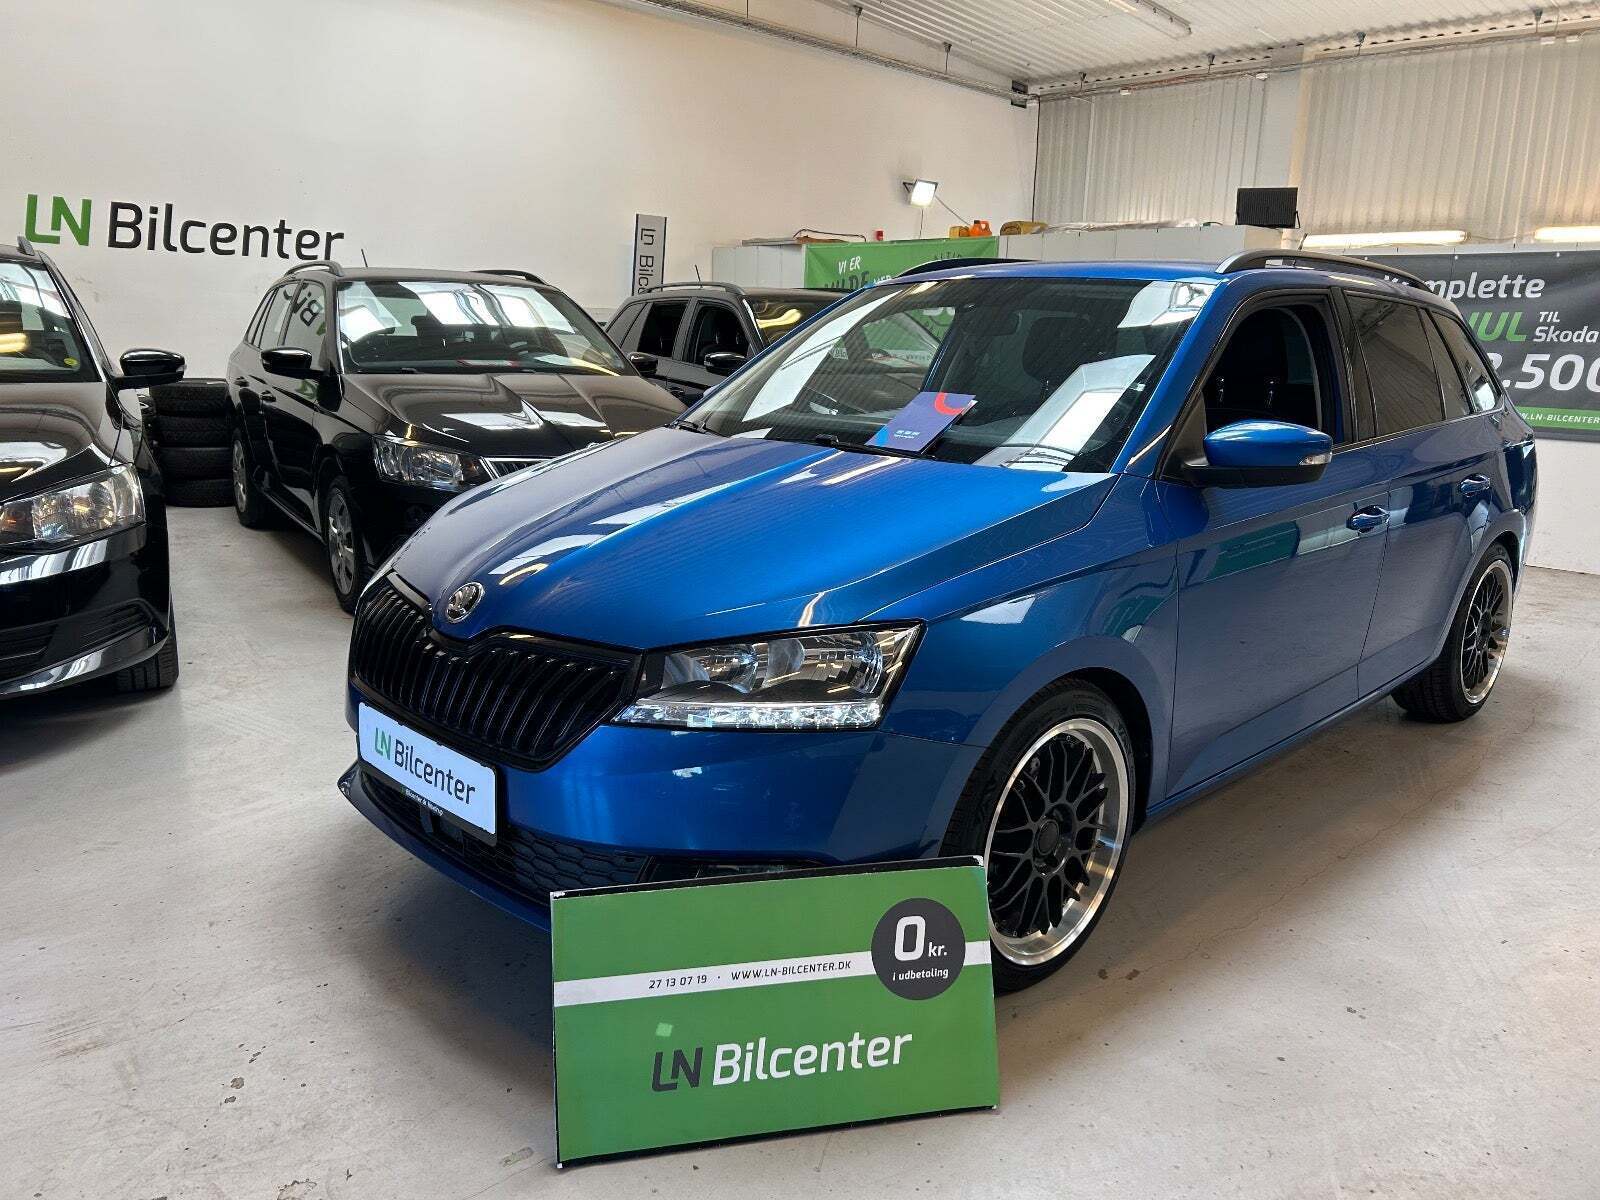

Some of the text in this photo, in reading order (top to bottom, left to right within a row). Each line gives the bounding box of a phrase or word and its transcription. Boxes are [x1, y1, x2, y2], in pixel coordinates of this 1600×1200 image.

[25, 193, 345, 261] LN Bilcenter
[849, 256, 861, 271] ER
[1539, 311, 1561, 323] TIL
[1533, 325, 1600, 343] Skoda
[374, 727, 392, 761] LN
[394, 738, 476, 805] Bilcenter
[894, 915, 948, 962] 0 kr.
[648, 960, 851, 990] 27 13 07 19 WWW.LN-BILCENTER.DK
[898, 967, 949, 981] udbetaling
[651, 1032, 913, 1093] LN Bilcenter
